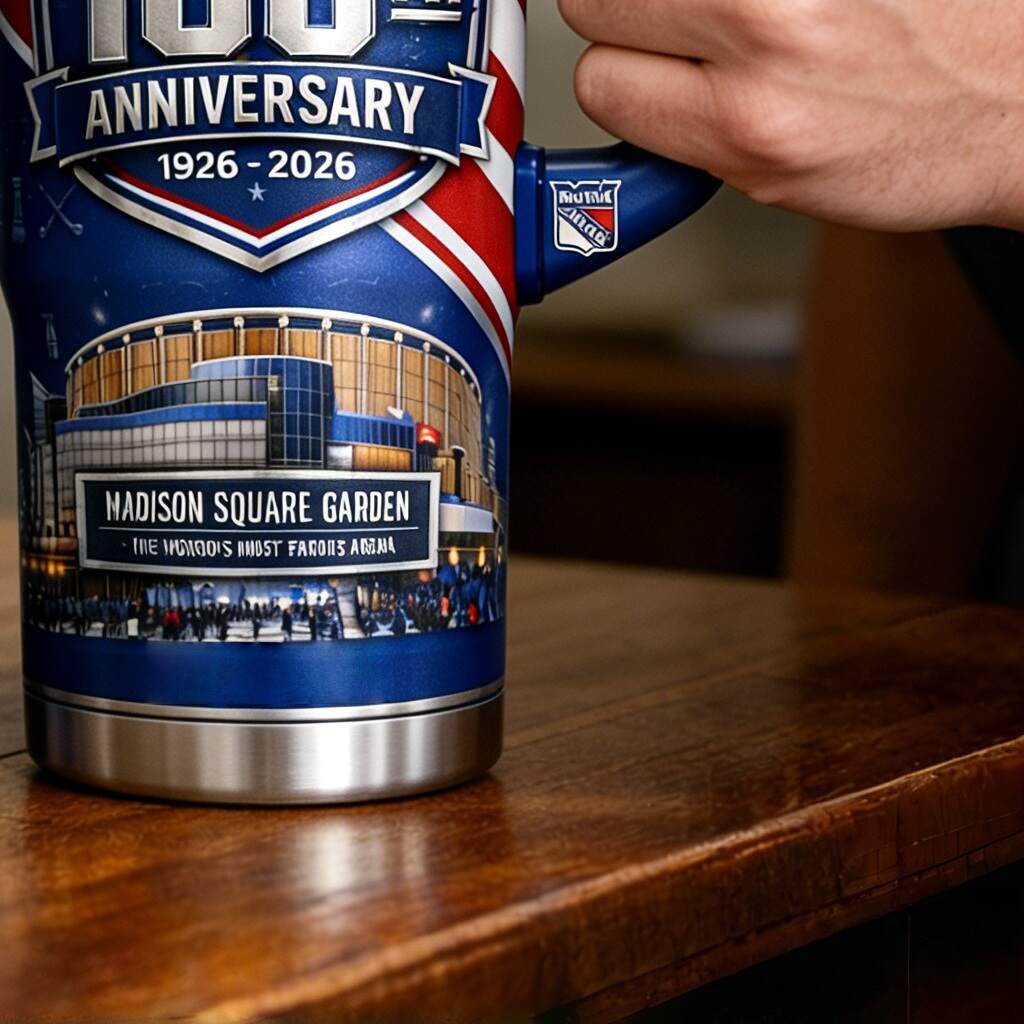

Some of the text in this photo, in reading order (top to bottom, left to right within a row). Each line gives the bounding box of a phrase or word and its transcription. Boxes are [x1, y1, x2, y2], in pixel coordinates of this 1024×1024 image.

[84, 73, 425, 140] ANNIVERSARY
[157, 150, 239, 181] 1926
[267, 149, 357, 181] 2026
[106, 490, 410, 527] MADISON SQUARE GARDEN
